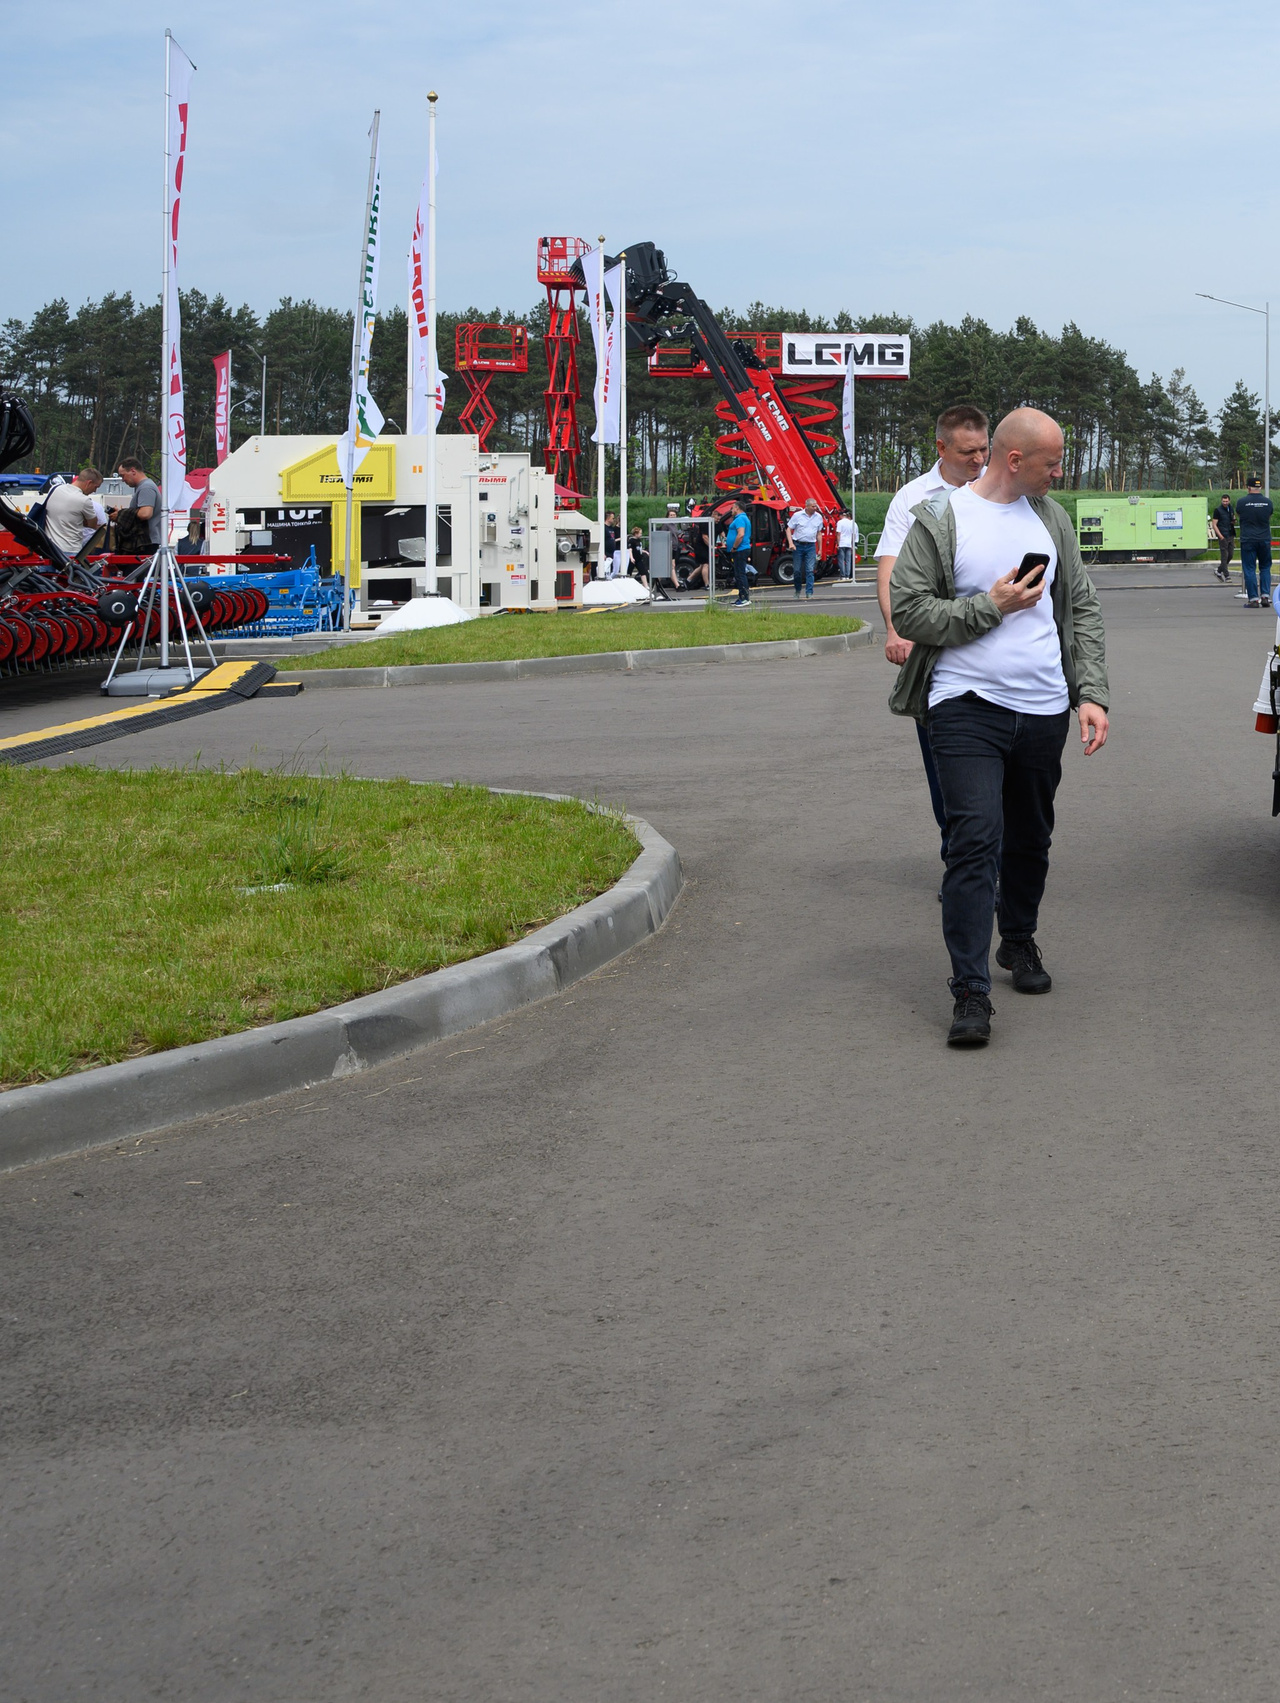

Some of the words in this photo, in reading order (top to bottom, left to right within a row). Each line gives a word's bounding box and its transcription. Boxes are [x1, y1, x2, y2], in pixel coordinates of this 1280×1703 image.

[788, 343, 904, 365] LGMG
[761, 391, 790, 432] LGMG
[753, 415, 773, 442] LGMG
[478, 475, 507, 483] ЛЫМЯ
[773, 475, 792, 503] LGMG
[212, 520, 226, 533] 11
